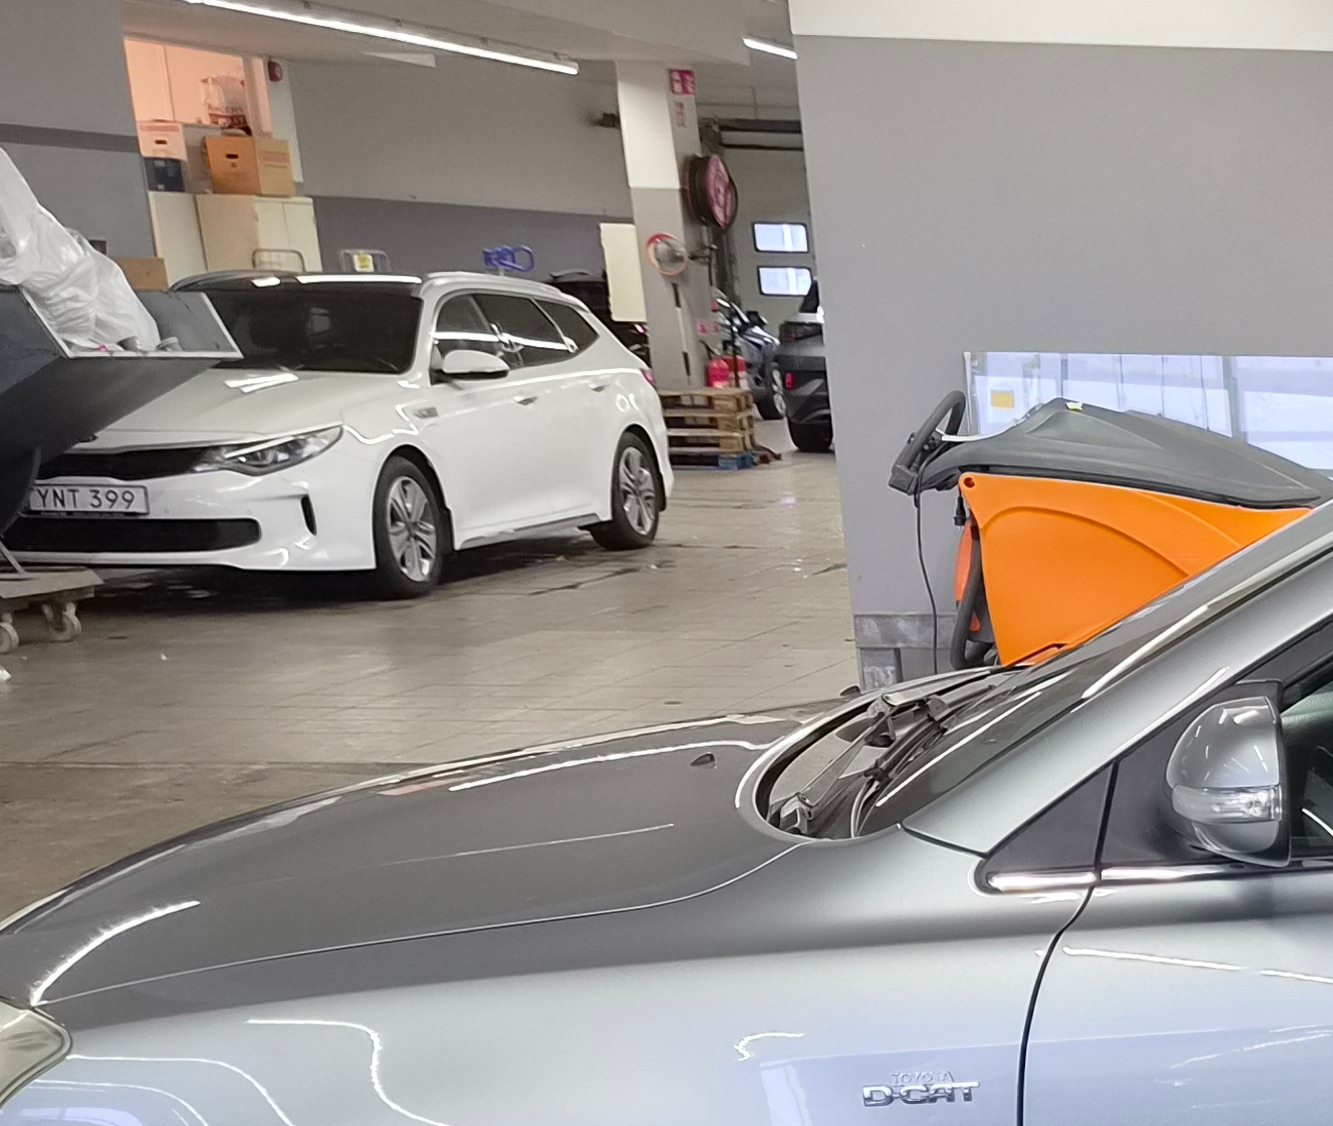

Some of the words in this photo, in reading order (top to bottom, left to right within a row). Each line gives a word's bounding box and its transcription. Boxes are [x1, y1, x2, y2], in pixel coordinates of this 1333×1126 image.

[36, 487, 80, 509] YNT
[89, 488, 135, 509] 399
[890, 1071, 955, 1085] TOYOTA
[862, 1081, 980, 1107] D-CAT
